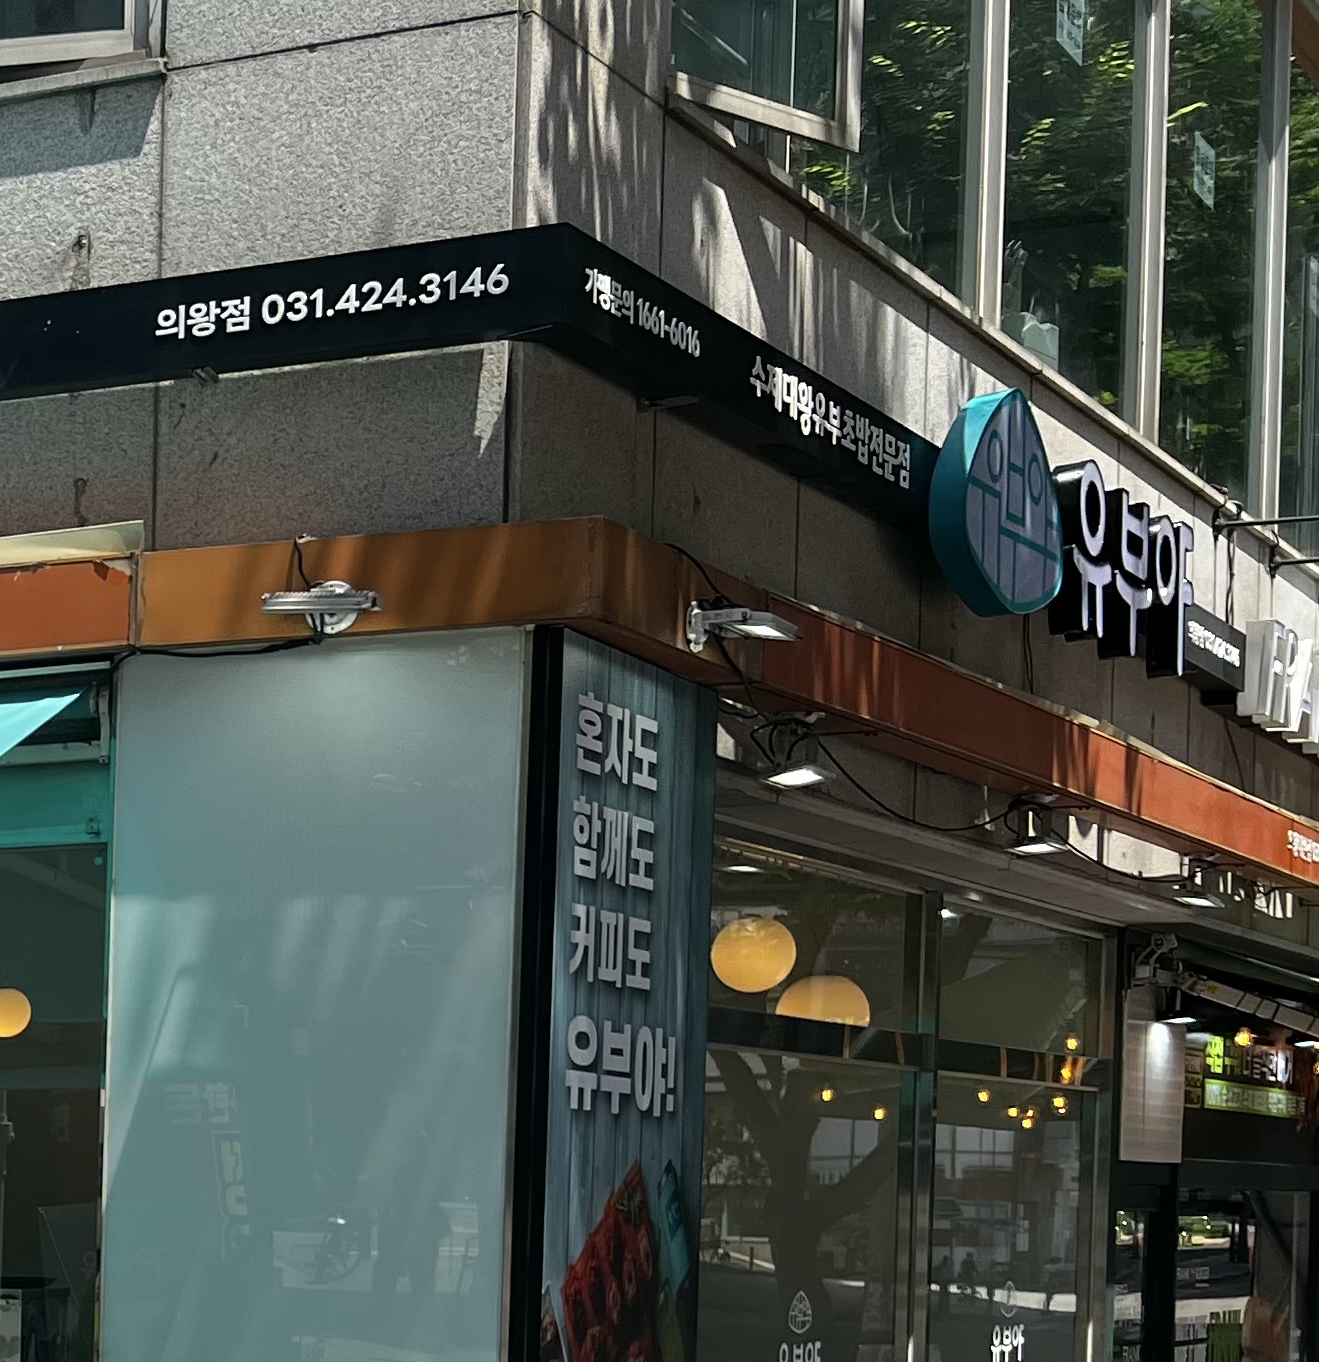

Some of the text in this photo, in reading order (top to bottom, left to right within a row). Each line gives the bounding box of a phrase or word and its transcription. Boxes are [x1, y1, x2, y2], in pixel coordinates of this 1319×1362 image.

[155, 263, 510, 341] 의왕점 031.424.3146
[585, 267, 701, 358] 가맹문의 1661-6016
[750, 353, 912, 490] 수제대왕유부초밥전문점
[1070, 459, 1195, 677] 유부야
[575, 690, 659, 792] 혼자도
[573, 795, 655, 892] 함께도
[569, 903, 652, 992] 커피도
[565, 1013, 677, 1118] 유부야!
